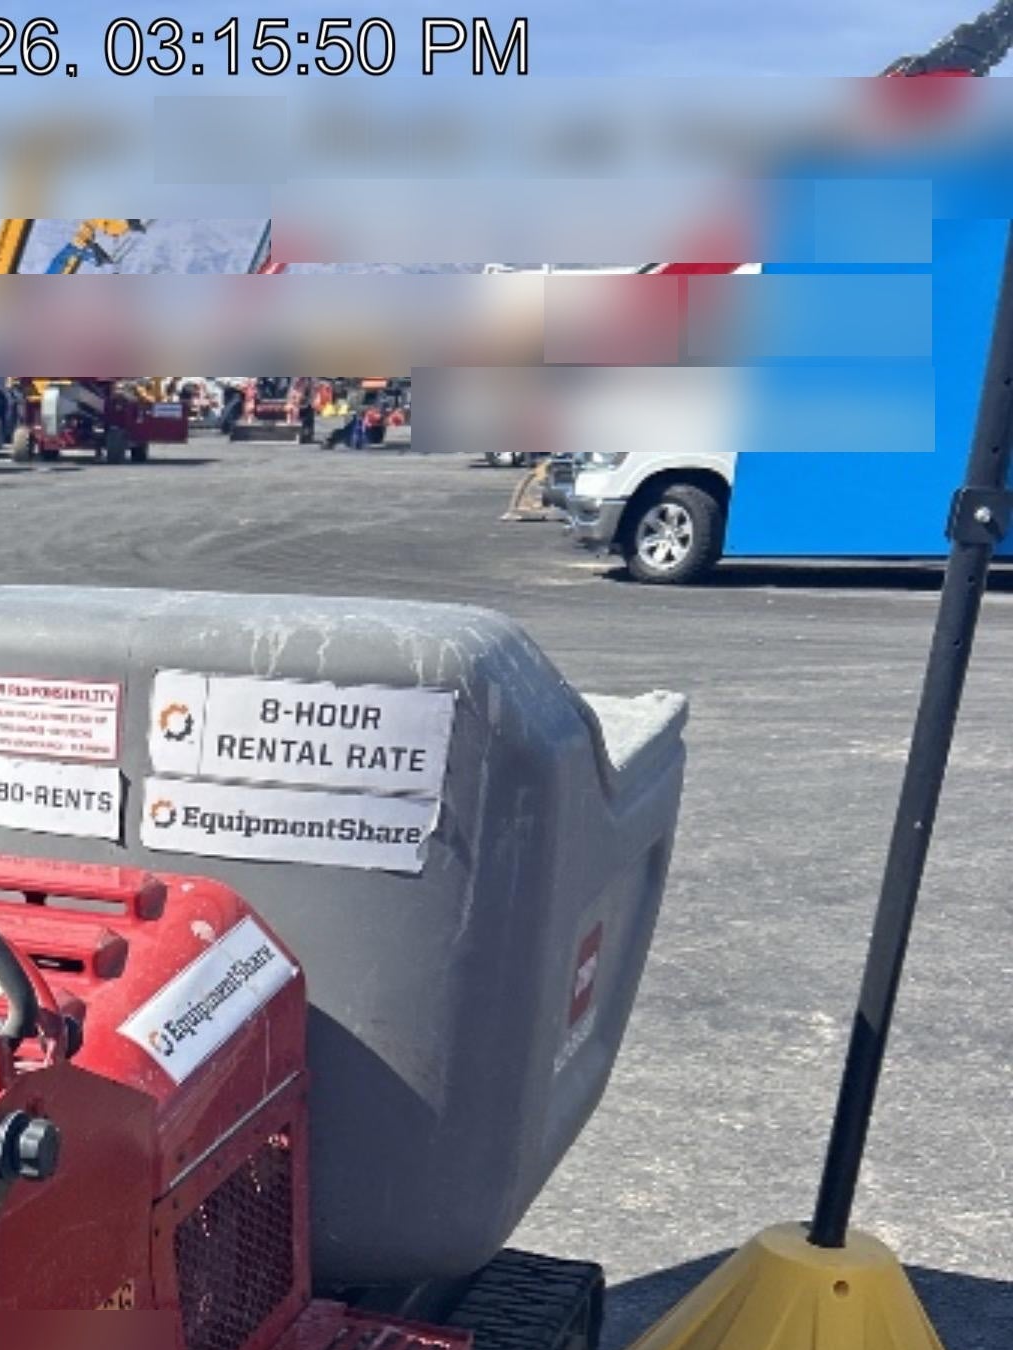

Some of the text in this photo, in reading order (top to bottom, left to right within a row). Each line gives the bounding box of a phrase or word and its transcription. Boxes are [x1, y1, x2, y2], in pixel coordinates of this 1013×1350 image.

[259, 697, 382, 730] 8-HOUR
[217, 734, 427, 773] RENTAL RATE
[181, 804, 422, 845] EquipmentShare
[163, 943, 276, 1043] EquipmentShare
